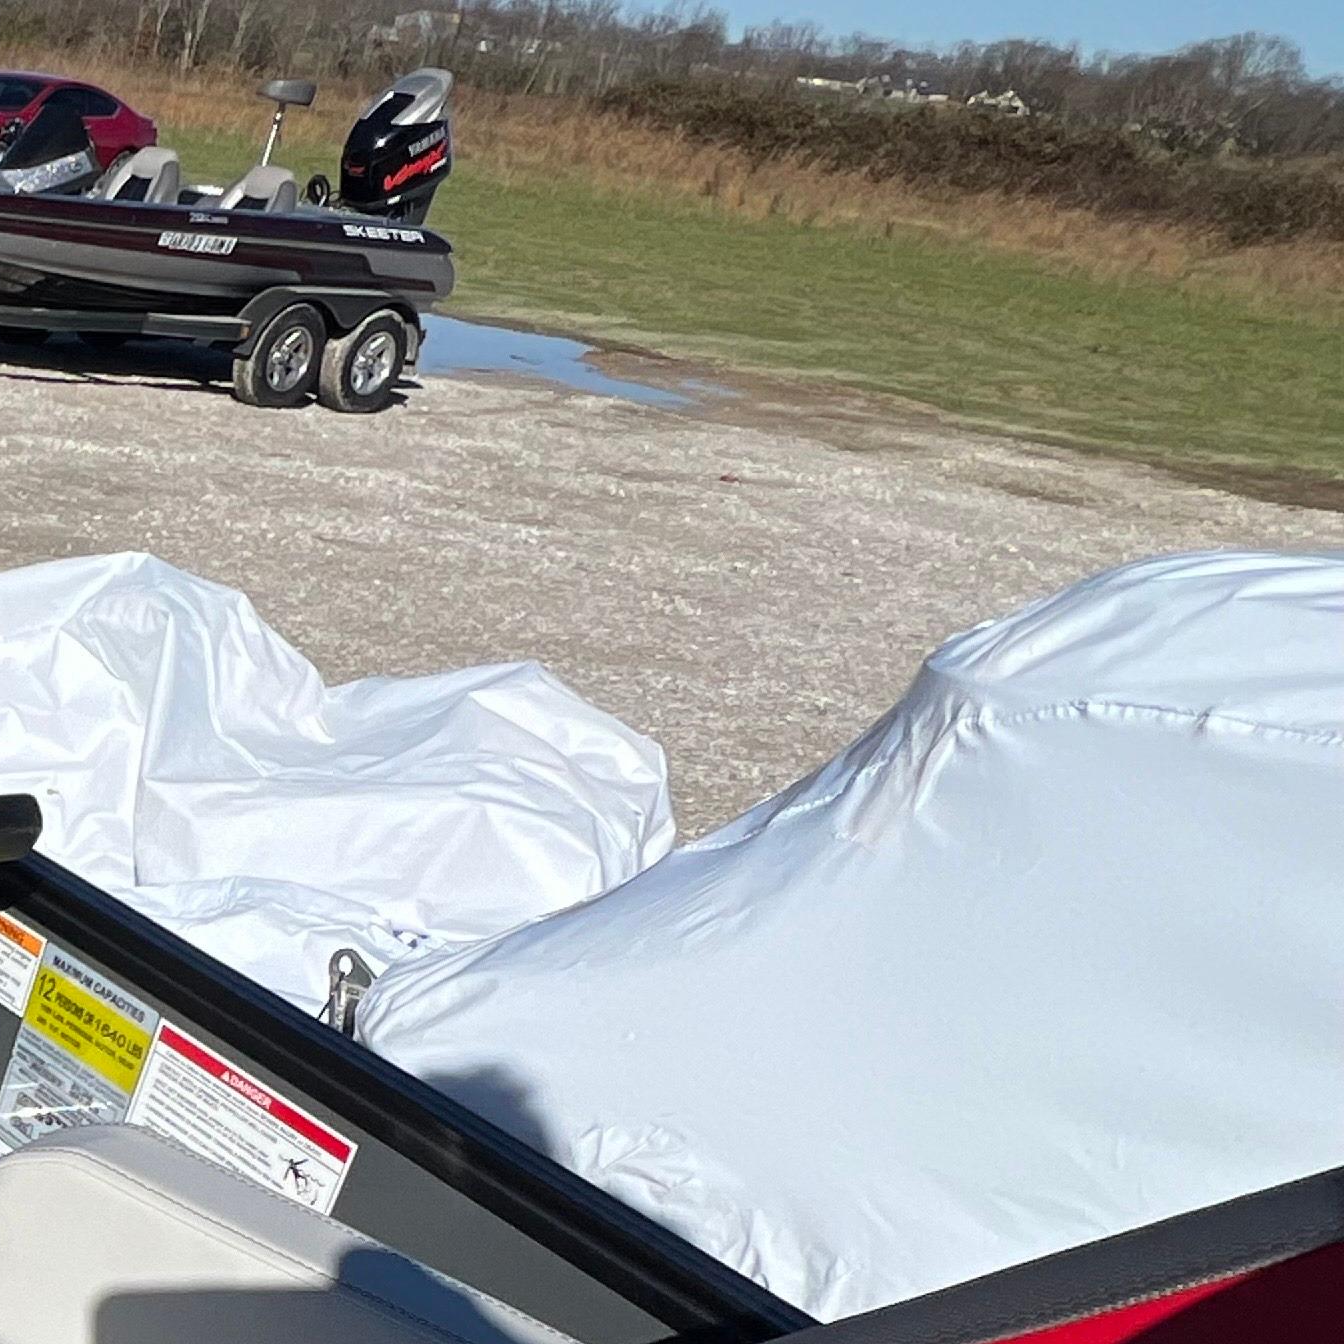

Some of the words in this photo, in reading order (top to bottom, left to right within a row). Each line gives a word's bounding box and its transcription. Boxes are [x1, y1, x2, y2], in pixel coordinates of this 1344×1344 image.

[342, 224, 426, 245] SKEETER
[39, 973, 57, 1002] 12
[92, 982, 146, 1024] CAPACITIES
[229, 1073, 273, 1111] DANGER
